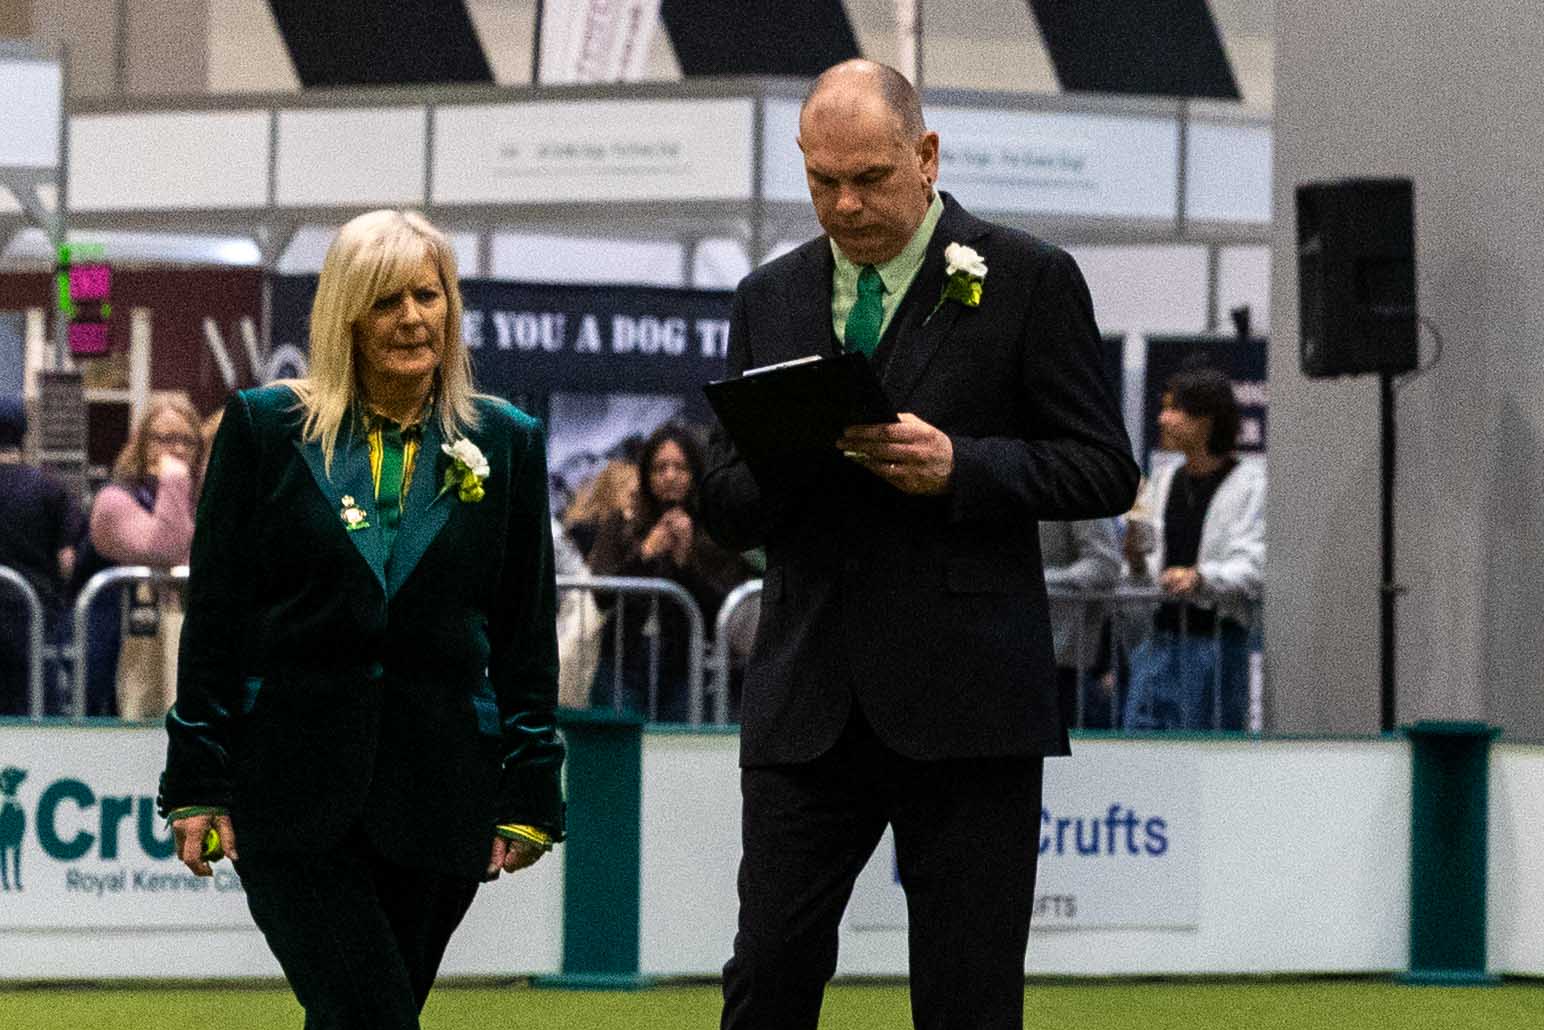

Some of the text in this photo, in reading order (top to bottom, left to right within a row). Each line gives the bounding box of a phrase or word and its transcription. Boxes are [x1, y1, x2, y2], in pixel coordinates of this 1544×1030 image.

[492, 310, 566, 352] YOU
[573, 313, 602, 353] A
[612, 315, 687, 355] DOG
[37, 777, 176, 861] Cru
[66, 867, 127, 896] Royal
